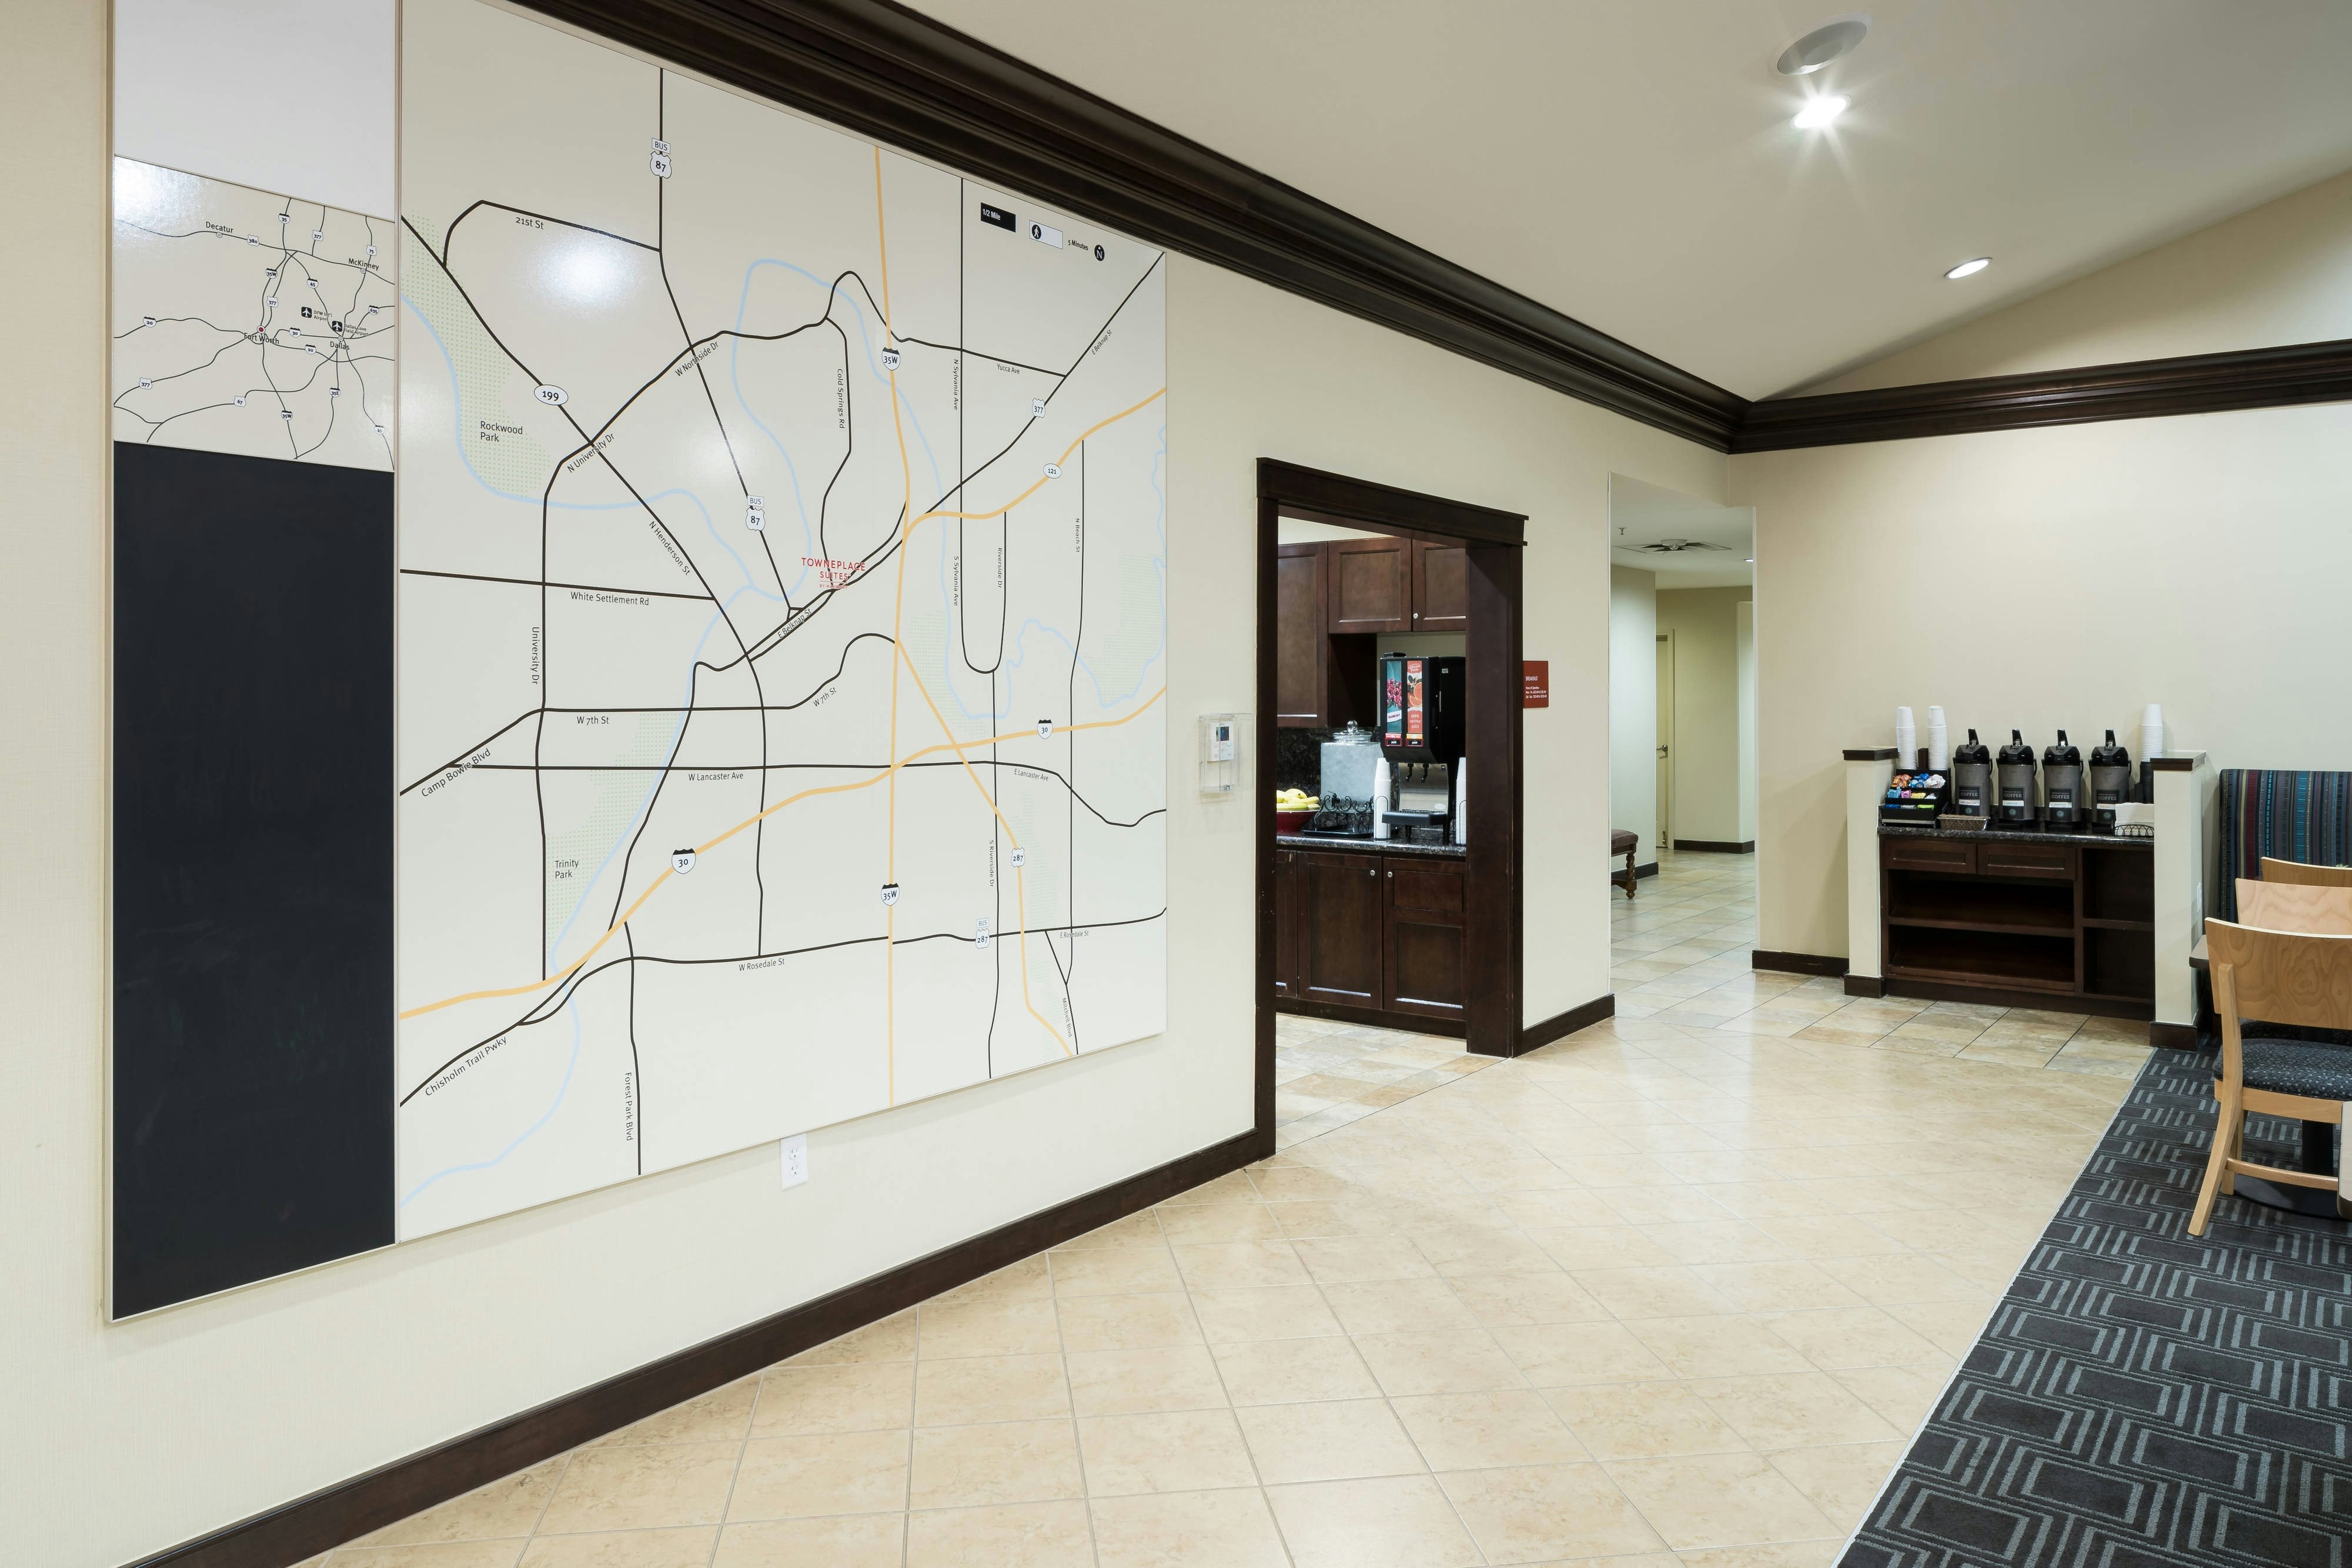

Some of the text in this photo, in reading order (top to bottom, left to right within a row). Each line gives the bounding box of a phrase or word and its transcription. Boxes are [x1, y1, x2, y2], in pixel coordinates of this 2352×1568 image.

[654, 141, 668, 151] BUS
[655, 160, 666, 172] 87
[991, 212, 1001, 220] Mile
[206, 221, 233, 233] Decatur
[515, 218, 544, 230] 21st St
[1071, 240, 1088, 250] Minutes
[1096, 250, 1103, 259] N
[348, 258, 379, 271] McKinney
[244, 333, 279, 345] Fort Worth
[1095, 335, 1108, 352] Belknap
[330, 341, 350, 350] Dallas
[674, 341, 719, 377] W Northside Dr
[884, 356, 898, 365] 35W
[997, 363, 1011, 373] Yucca
[542, 390, 559, 402] 199
[1034, 406, 1044, 414] 377
[480, 420, 523, 435] Rockwood
[839, 418, 845, 429] Rd
[480, 432, 500, 443] Park
[567, 433, 615, 473] N University Dr
[750, 497, 761, 506] BUS
[750, 516, 760, 526] 87
[649, 521, 690, 576] N Henderson St
[801, 557, 866, 571] TOWNEPLACE
[820, 571, 848, 581] SUITES
[570, 591, 649, 606] White Settlement Rd
[781, 614, 804, 636] Belknap
[804, 609, 812, 618] St
[530, 626, 540, 685] University Dr
[813, 687, 837, 707] W 7th St
[576, 716, 609, 726] W 7th St
[422, 748, 491, 797] Camp Bowie Blvd
[696, 772, 730, 781] Lancaster
[731, 772, 744, 780] Ave
[1018, 769, 1040, 779] Lancaster
[678, 858, 689, 868] 30
[1013, 854, 1024, 862] 287
[554, 859, 579, 869] Trinity
[555, 870, 573, 879] Park
[883, 890, 898, 901] 35W
[977, 935, 988, 944] 287
[739, 958, 785, 972] W Rosedale St
[425, 1037, 507, 1096] Chisholm Trail Pwky
